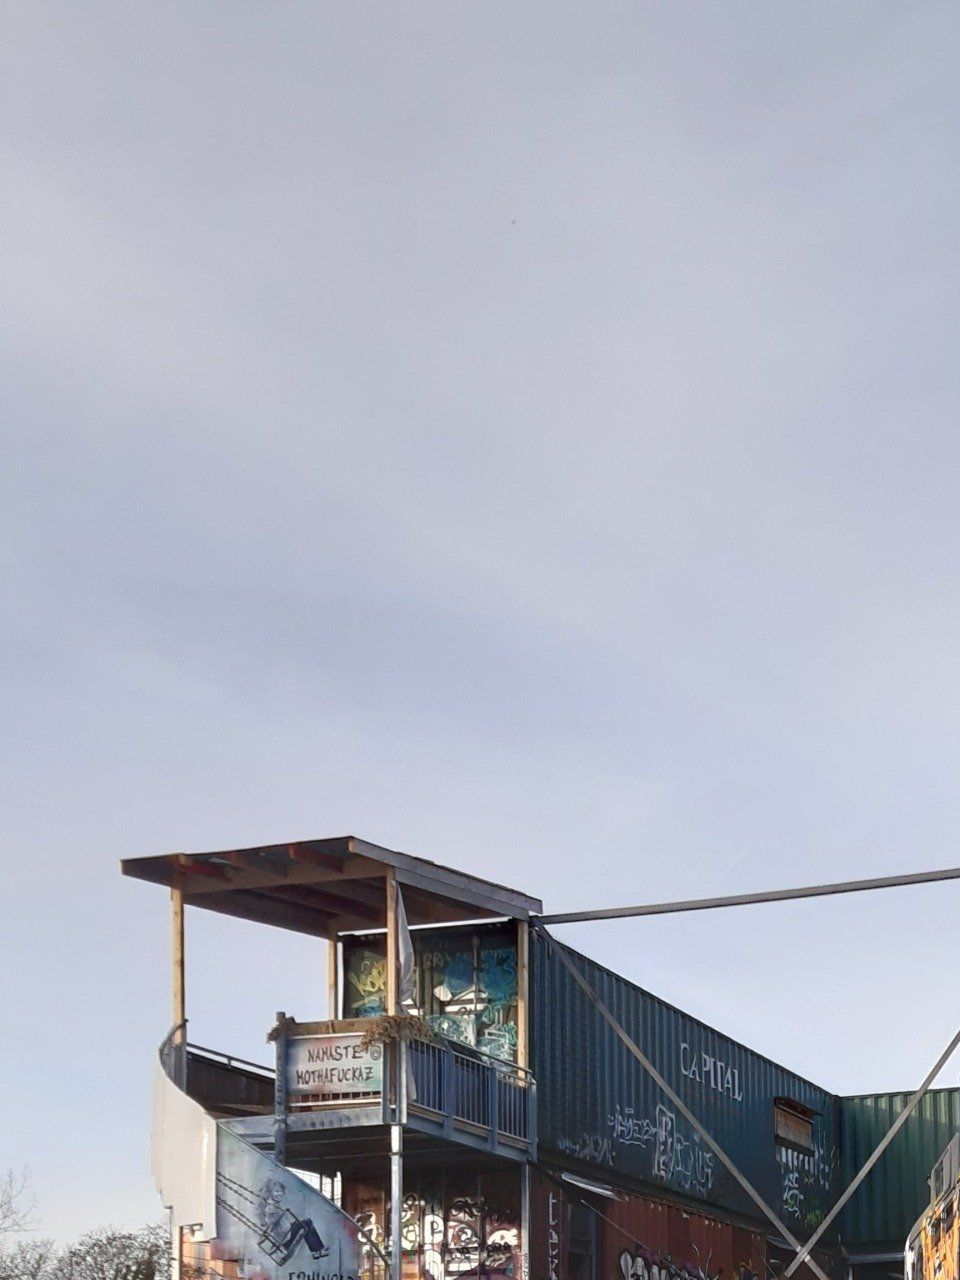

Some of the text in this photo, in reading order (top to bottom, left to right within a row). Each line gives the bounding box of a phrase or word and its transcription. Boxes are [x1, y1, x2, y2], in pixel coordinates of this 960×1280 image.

[307, 1045, 363, 1062] NAMASTE
[296, 1066, 374, 1085] MOTHAFUCKAZ
[680, 1043, 742, 1101] CAPITAL
